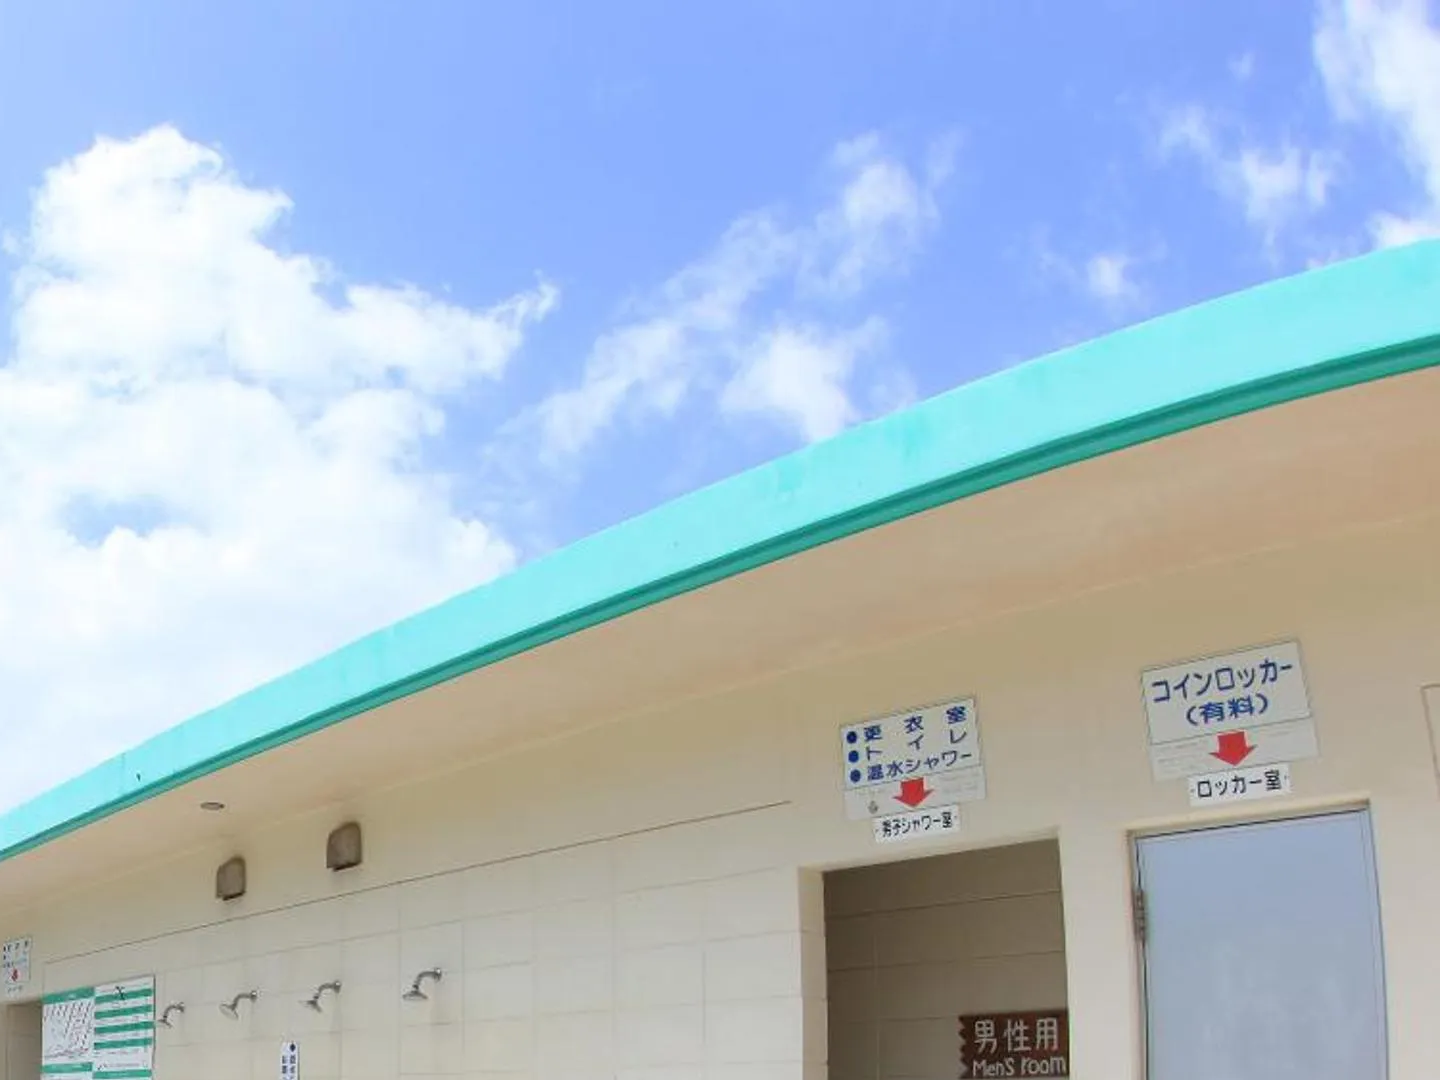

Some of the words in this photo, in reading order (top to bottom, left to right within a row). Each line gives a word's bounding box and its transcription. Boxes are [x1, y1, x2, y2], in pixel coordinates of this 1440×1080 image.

[1151, 657, 1293, 703] コインロッカー
[867, 749, 973, 782] 温水シャワー
[1197, 769, 1282, 798] ロッカー室
[974, 1016, 1060, 1054] 男性用
[1020, 1055, 1067, 1076] room
